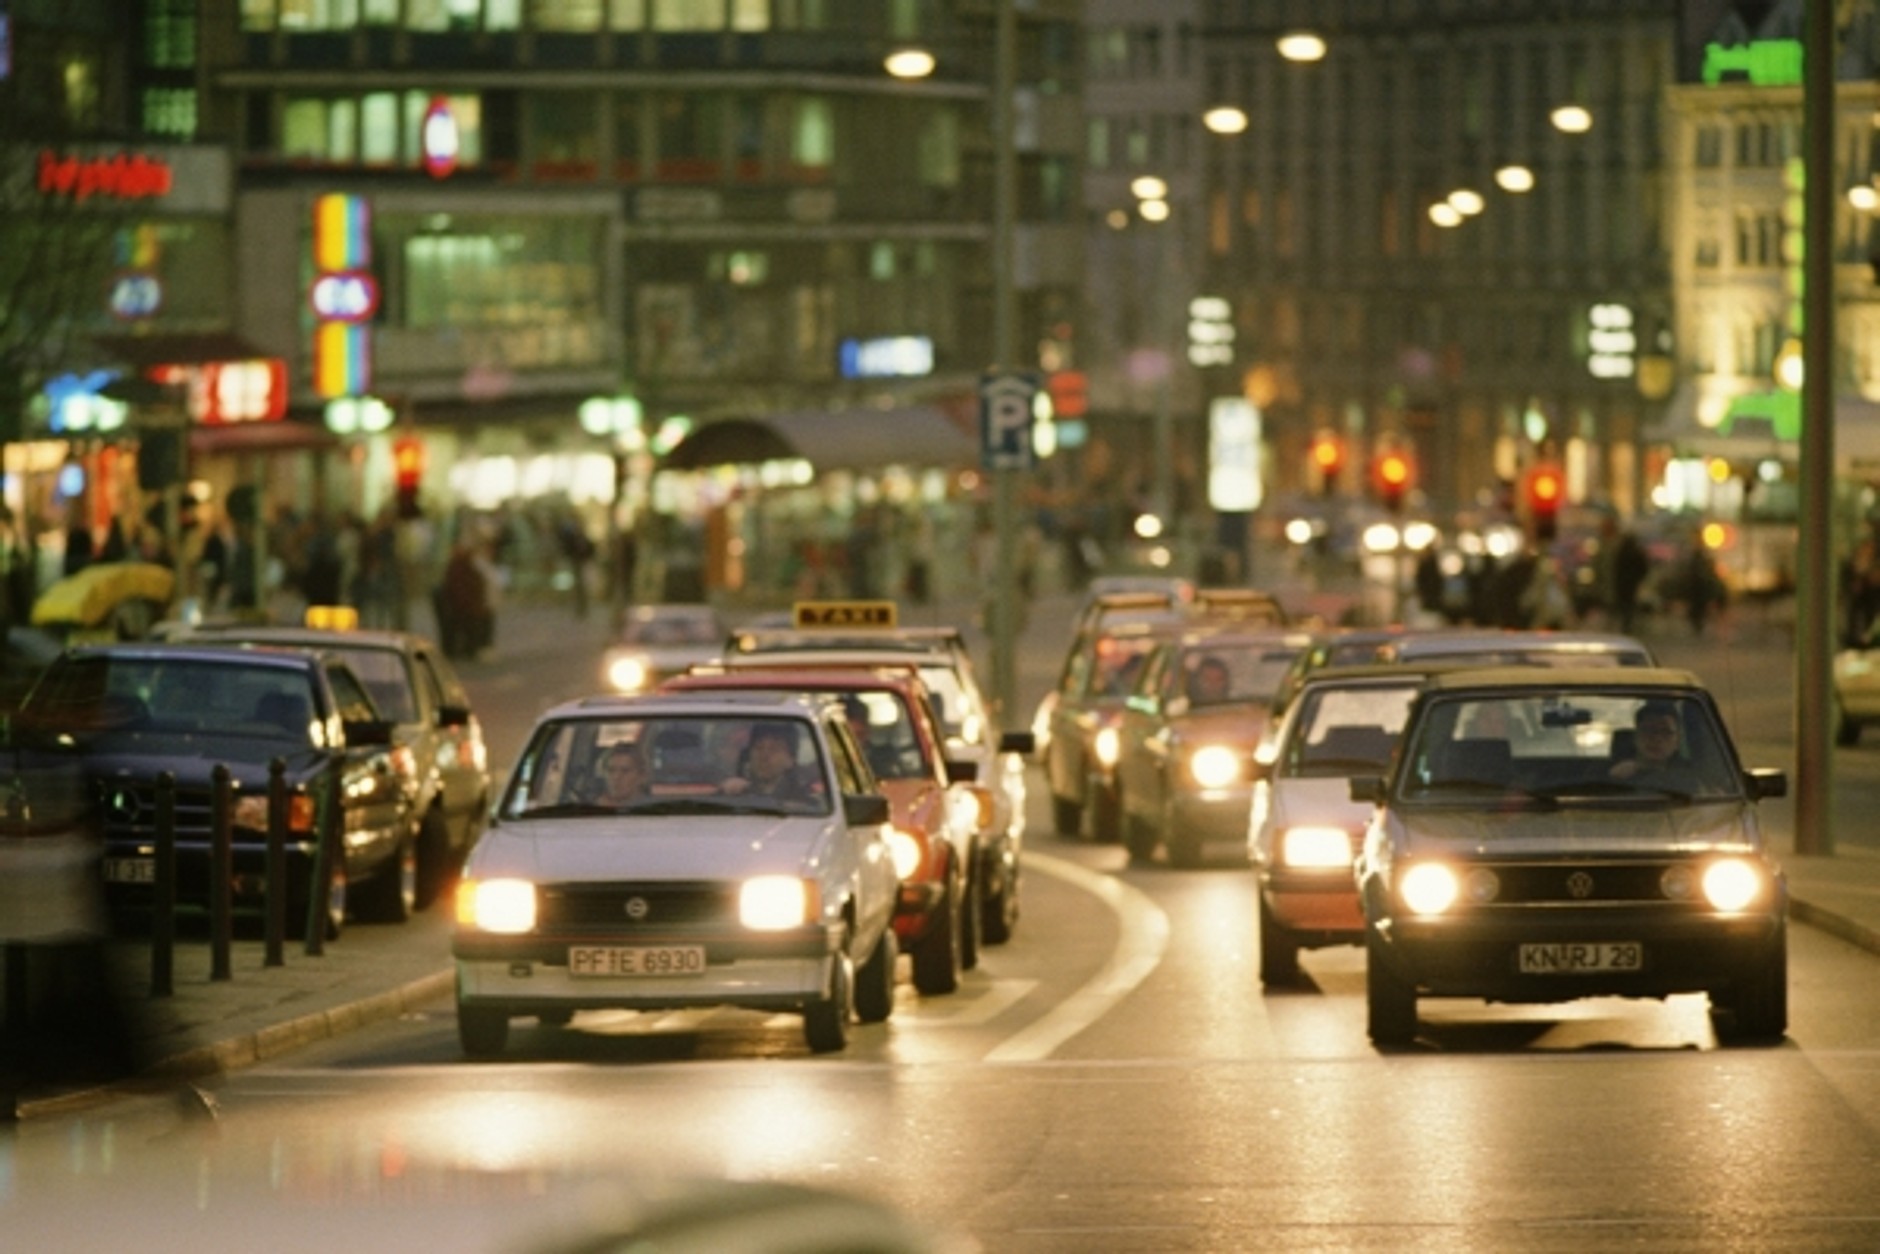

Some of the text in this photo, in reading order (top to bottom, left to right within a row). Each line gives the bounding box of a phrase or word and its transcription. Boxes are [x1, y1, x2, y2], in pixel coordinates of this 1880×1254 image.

[990, 394, 1029, 448] P
[799, 607, 890, 626] TAXI
[643, 949, 700, 973] 6930
[1610, 946, 1637, 967] 29
